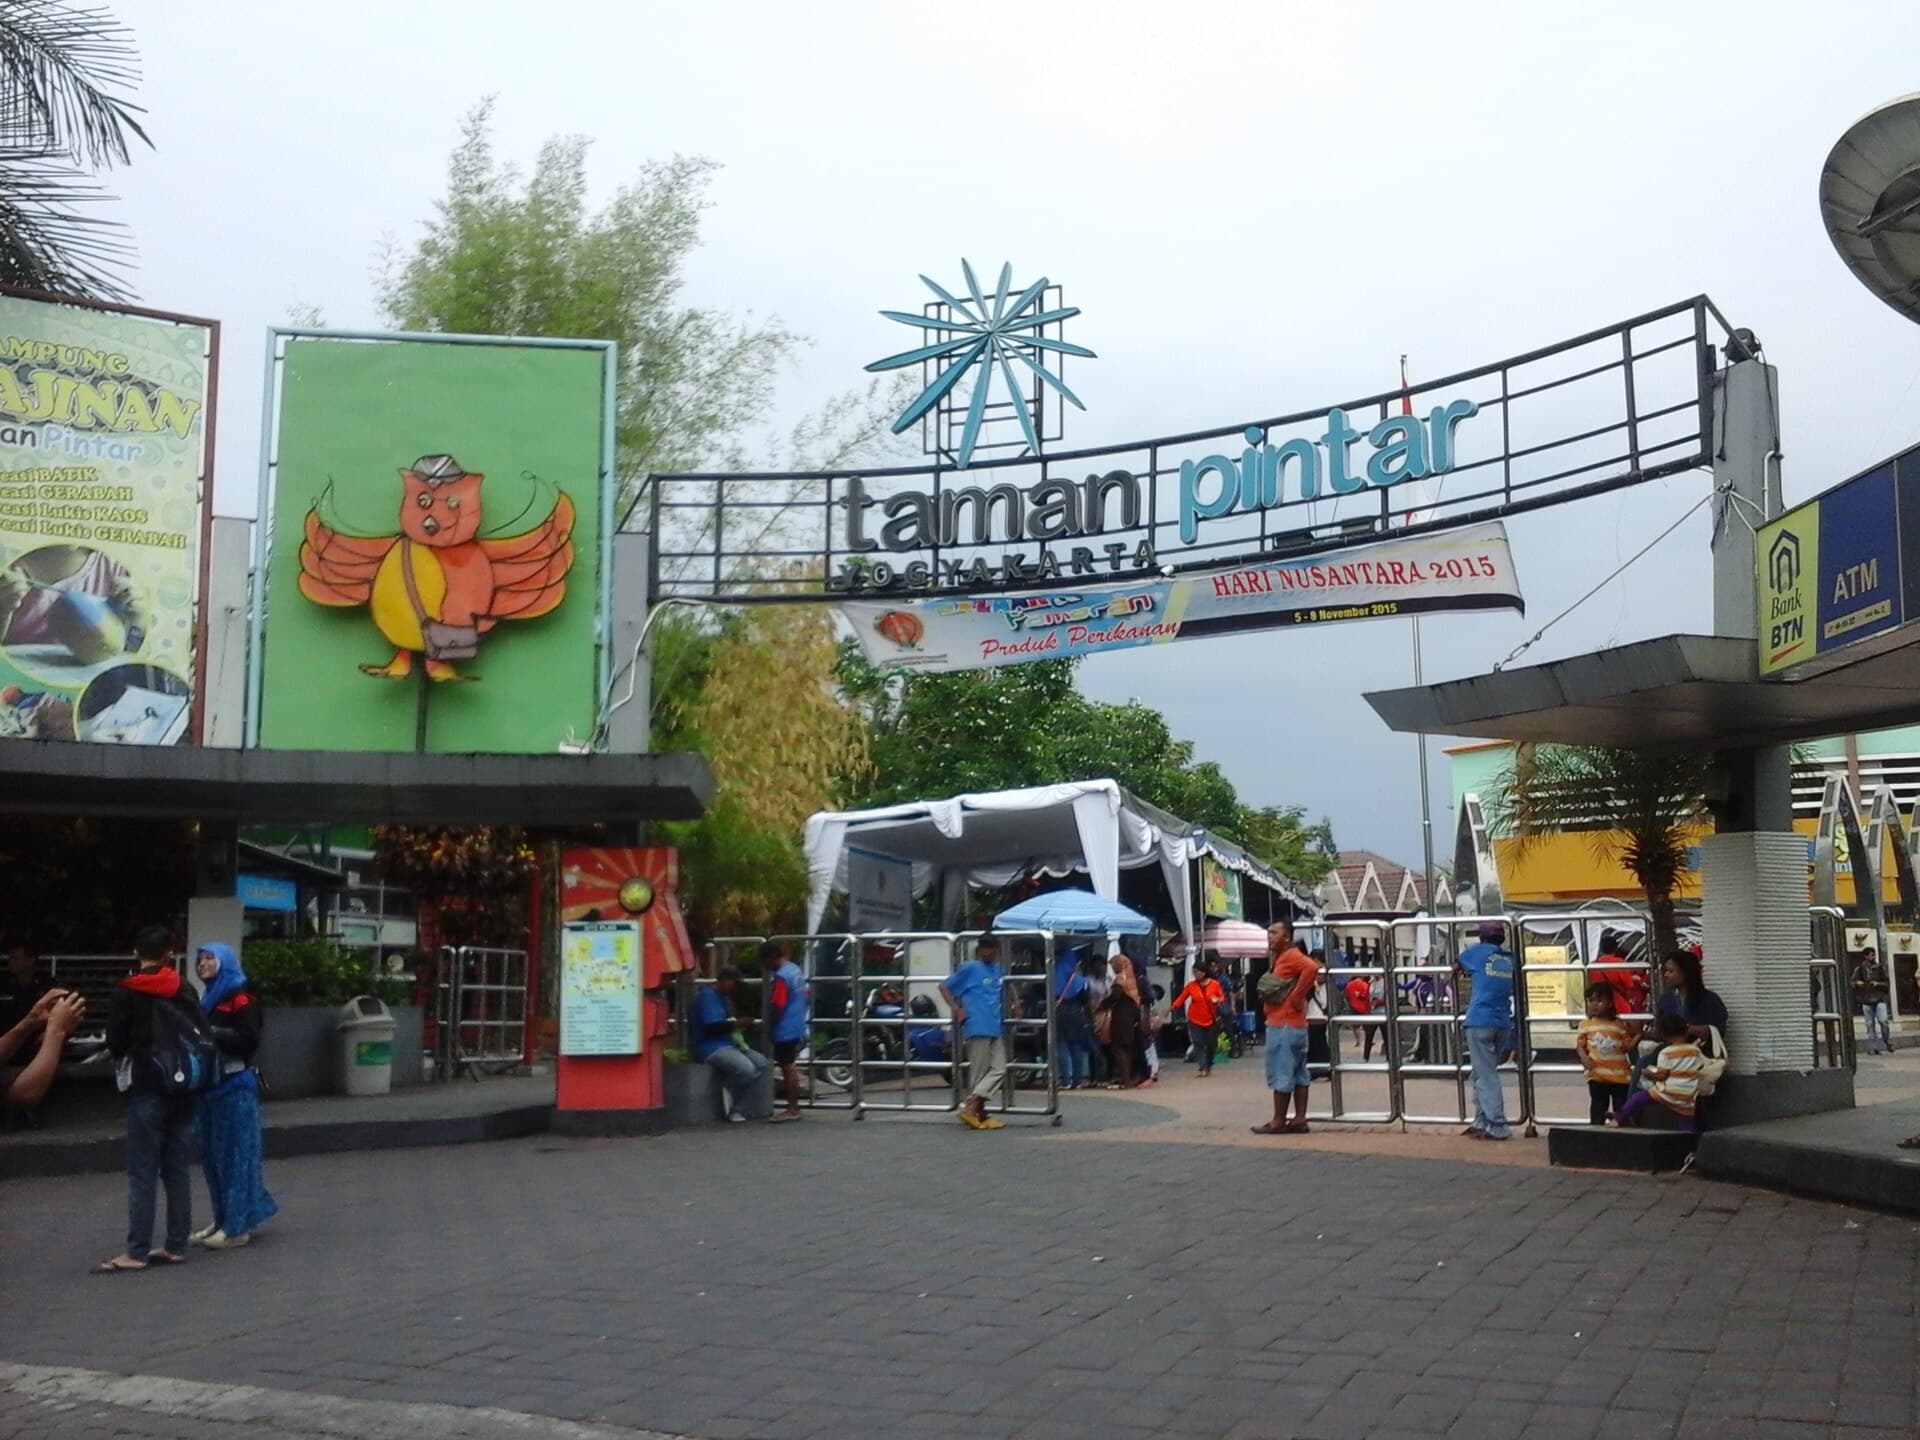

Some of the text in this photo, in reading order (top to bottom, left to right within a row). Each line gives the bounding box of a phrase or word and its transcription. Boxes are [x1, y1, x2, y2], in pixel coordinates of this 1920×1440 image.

[43, 425, 142, 460] Pintar
[37, 466, 99, 482] BATIK
[840, 399, 1478, 552] taman pintar
[39, 485, 133, 501] GERABAH
[94, 506, 148, 524] KAOS
[94, 526, 187, 549] GERABAH
[837, 540, 1157, 588] YOGYAKARTA
[1212, 556, 1496, 597] HARI NUSANTARA 2015
[1834, 558, 1878, 604] ATM
[1294, 612, 1301, 623] 5
[1319, 605, 1370, 620] November
[1371, 602, 1398, 616] 2015
[1771, 588, 1802, 620] Bank
[980, 632, 1058, 659] Produk
[1068, 620, 1177, 648] Perikanan
[1771, 615, 1803, 649] BTN
